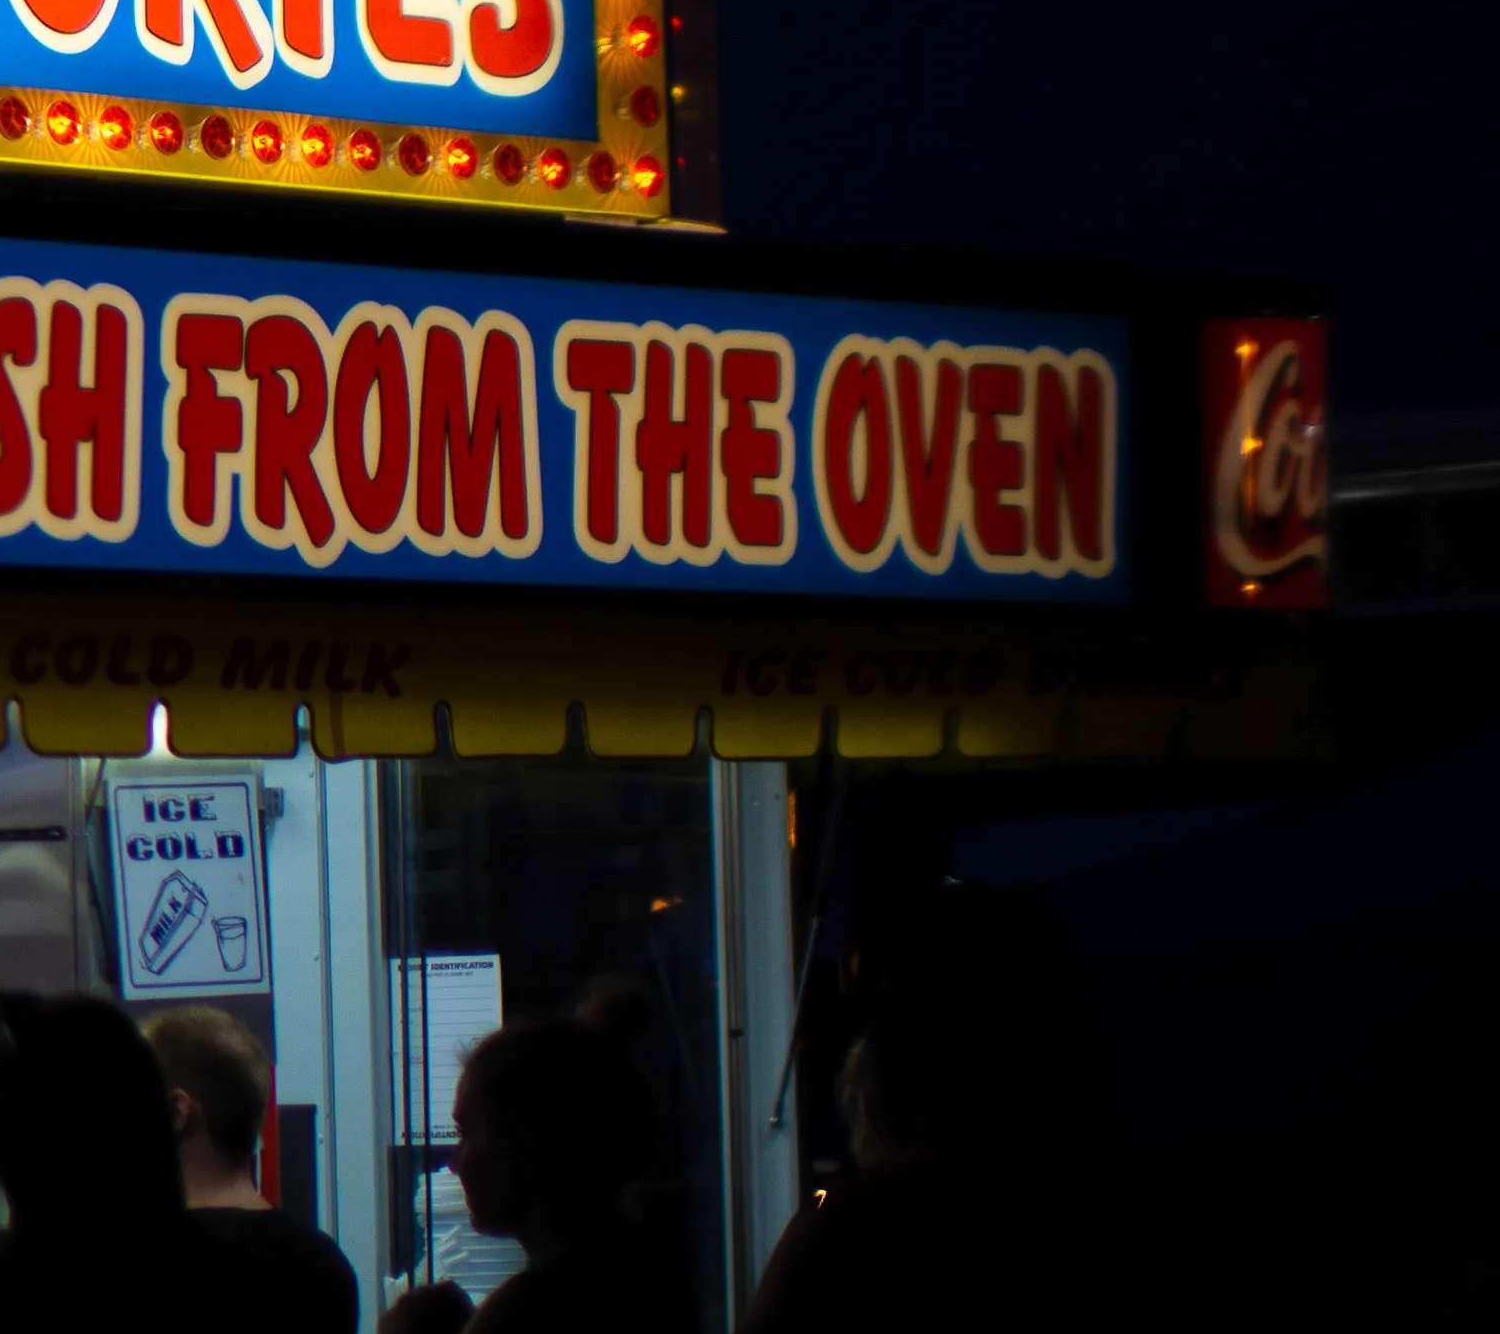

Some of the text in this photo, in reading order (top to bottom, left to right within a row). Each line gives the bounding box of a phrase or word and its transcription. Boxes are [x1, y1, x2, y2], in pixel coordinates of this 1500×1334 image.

[161, 291, 541, 569] FROM
[553, 318, 796, 567] THE
[811, 331, 1120, 579] OVEN
[8, 632, 195, 686] COLD
[220, 636, 414, 698] MILK
[722, 645, 823, 697] ICE
[143, 792, 218, 823] ICE
[125, 829, 246, 861] COLD
[149, 895, 184, 946] MILK
